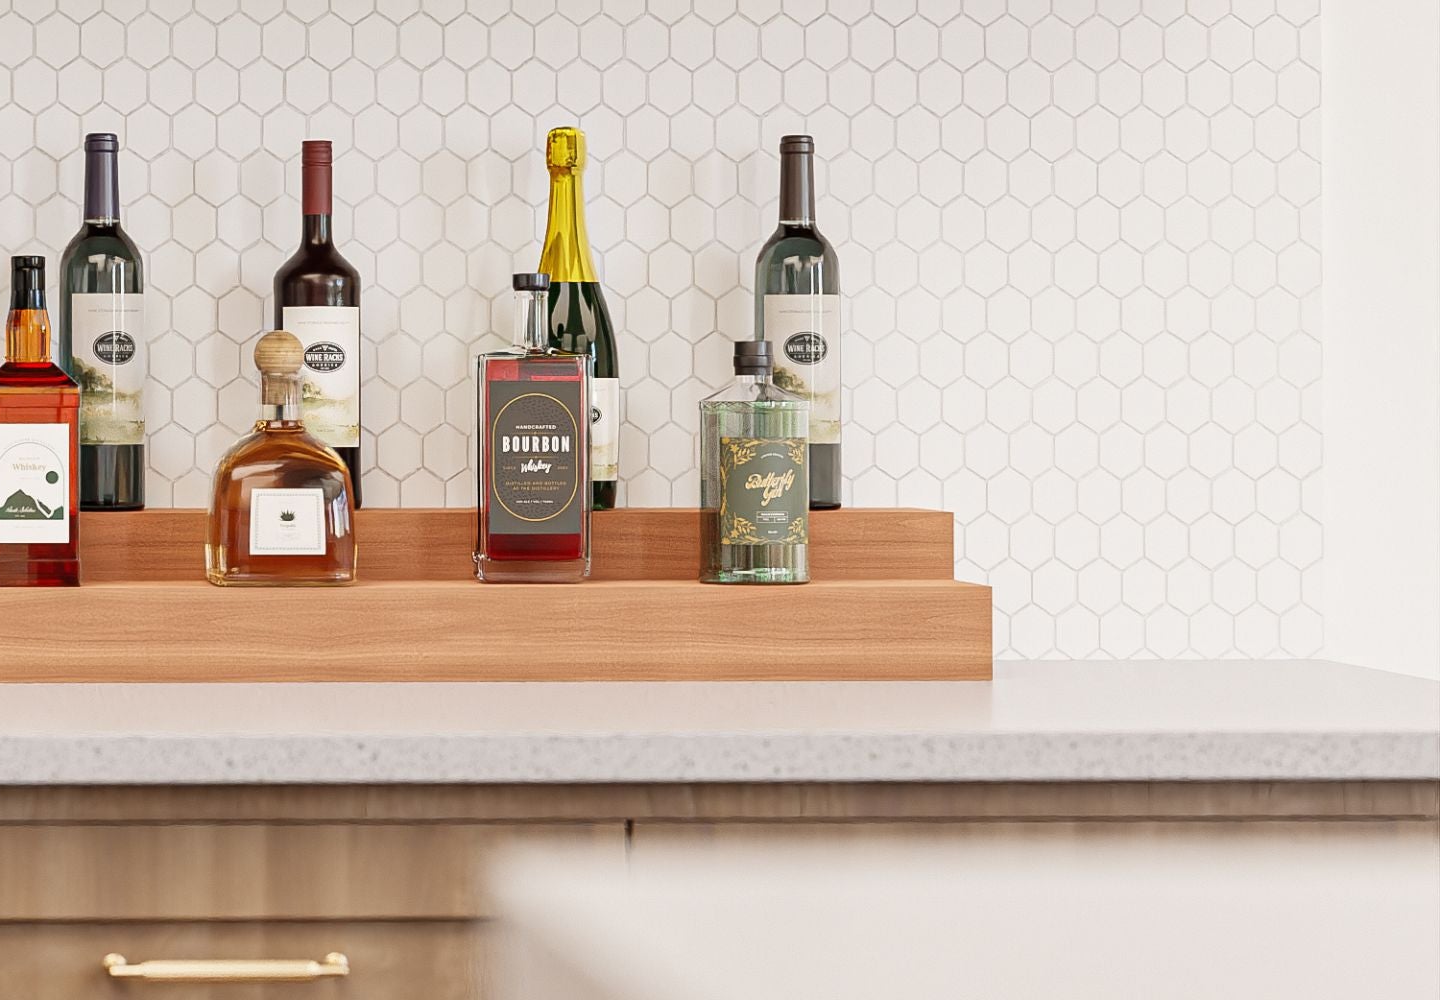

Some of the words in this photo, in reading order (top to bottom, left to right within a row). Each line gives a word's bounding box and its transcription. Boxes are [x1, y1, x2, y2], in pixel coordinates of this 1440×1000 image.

[787, 344, 804, 353] WINE
[306, 353, 323, 362] WINE
[502, 435, 570, 453] BOURBON
[12, 463, 47, 471] Whiskey
[520, 458, 552, 474] Whiskey
